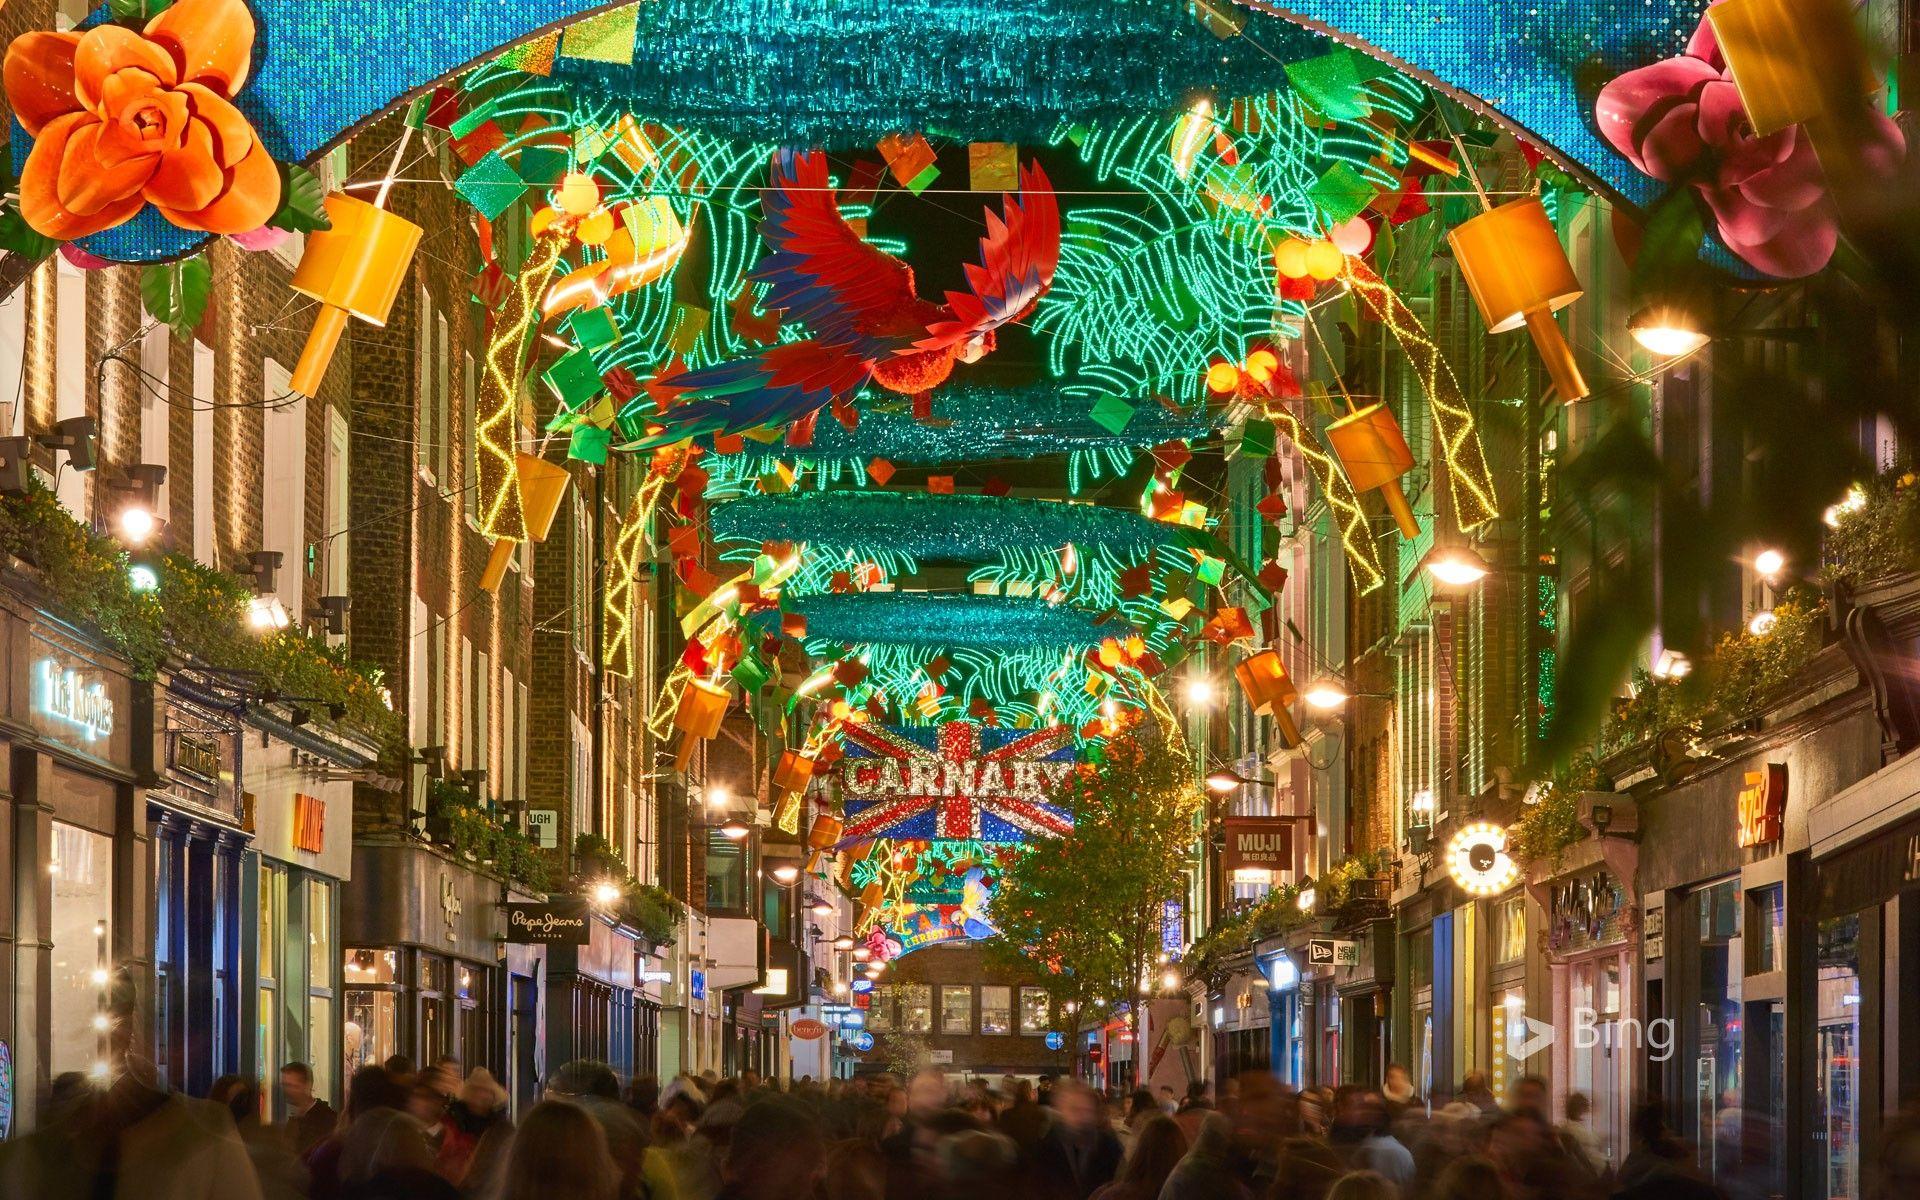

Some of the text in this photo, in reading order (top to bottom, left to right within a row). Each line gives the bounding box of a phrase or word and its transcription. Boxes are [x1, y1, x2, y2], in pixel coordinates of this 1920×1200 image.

[45, 659, 69, 718] The
[844, 755, 1075, 798] CARNABY
[1237, 833, 1281, 852] MUJI
[511, 910, 584, 933] Pepe Jeans
[1337, 945, 1356, 953] NEW
[1337, 953, 1356, 961] ERA
[793, 1024, 822, 1034] benefit
